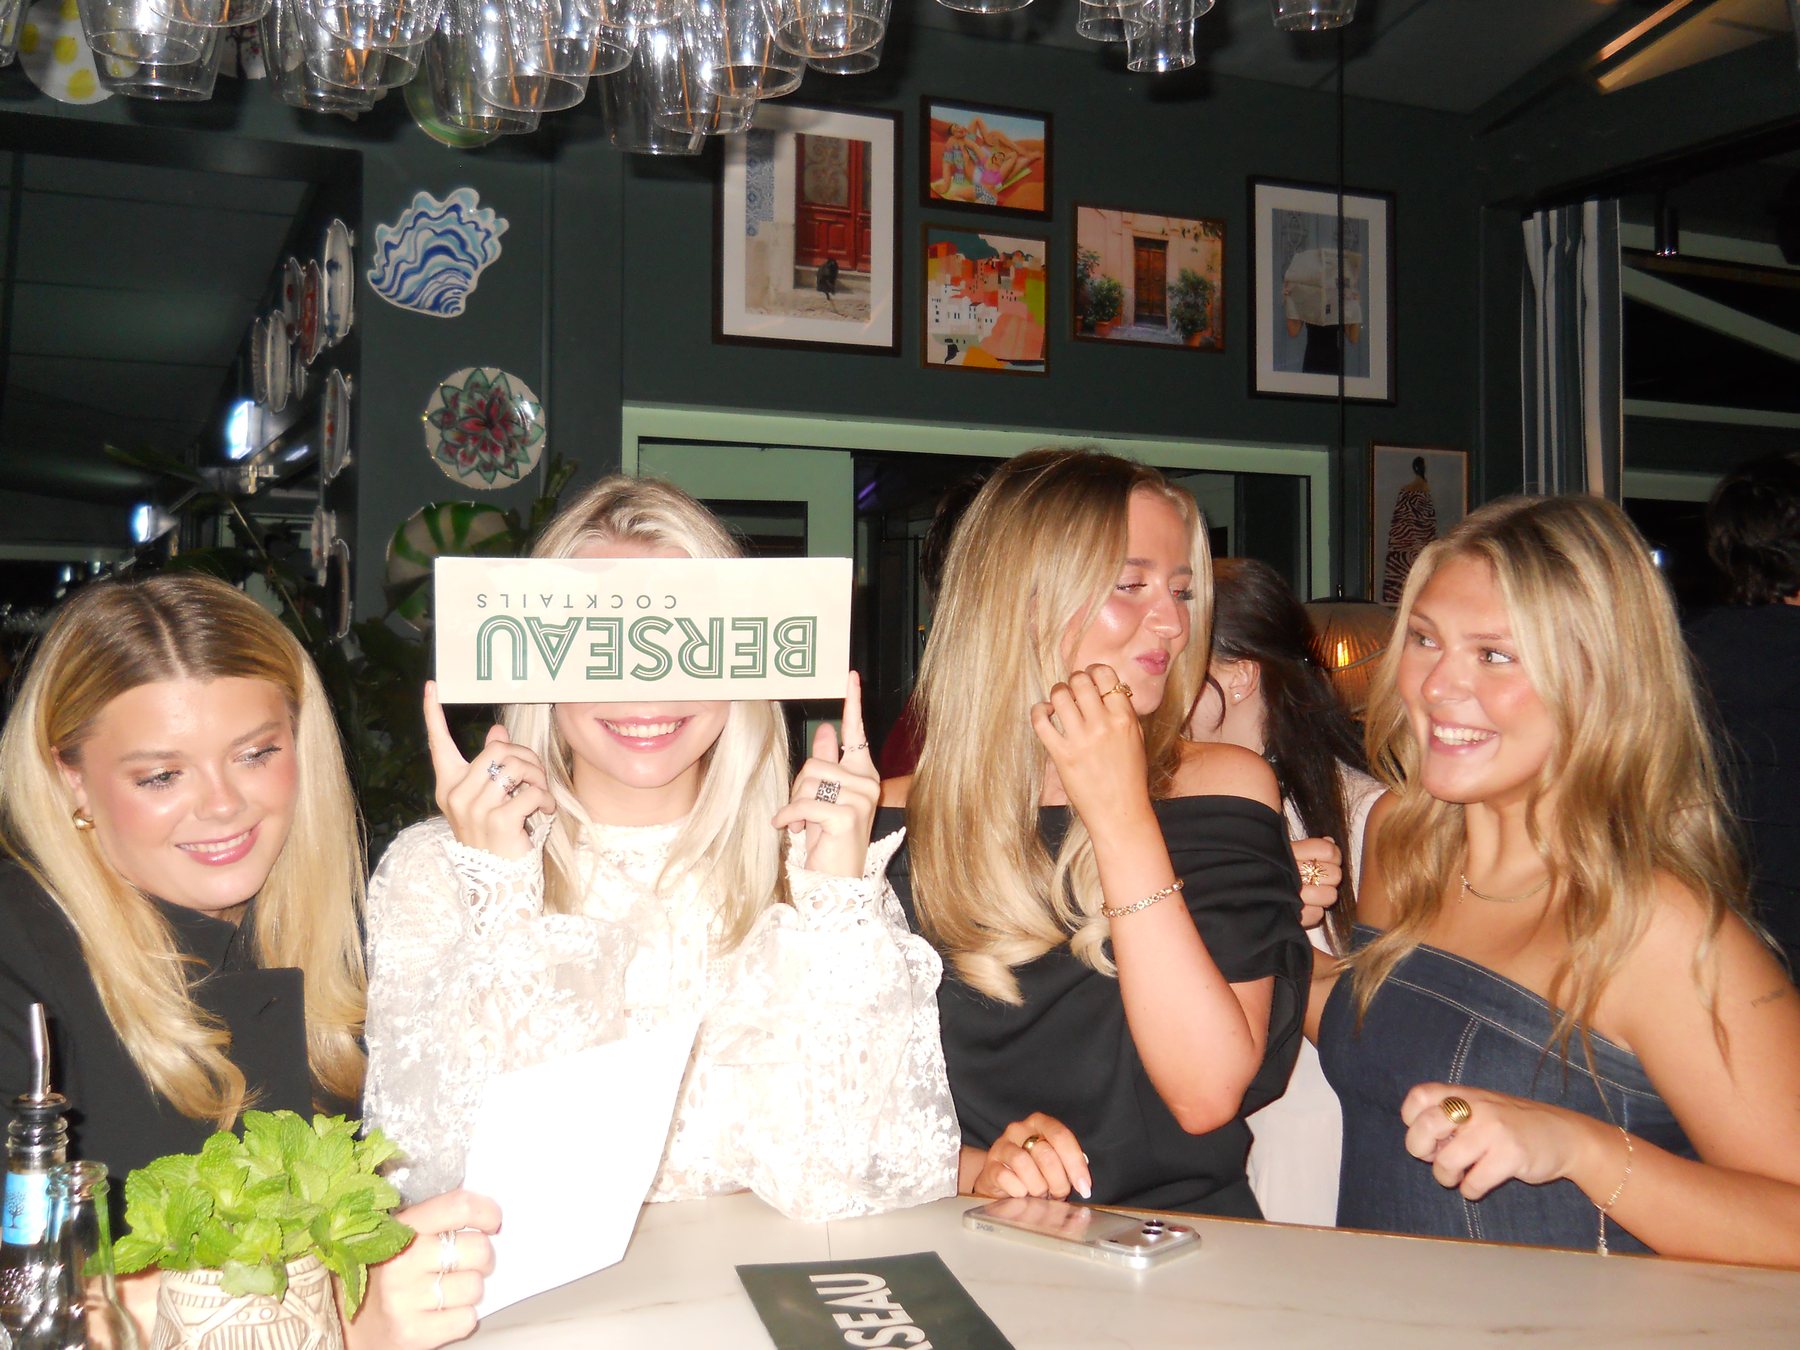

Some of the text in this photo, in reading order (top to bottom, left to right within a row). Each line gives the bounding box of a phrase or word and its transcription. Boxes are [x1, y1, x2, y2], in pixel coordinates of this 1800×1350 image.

[477, 594, 677, 608] COCKTAILS
[477, 615, 817, 681] BERSEAU
[809, 1273, 933, 1350] SEAU
